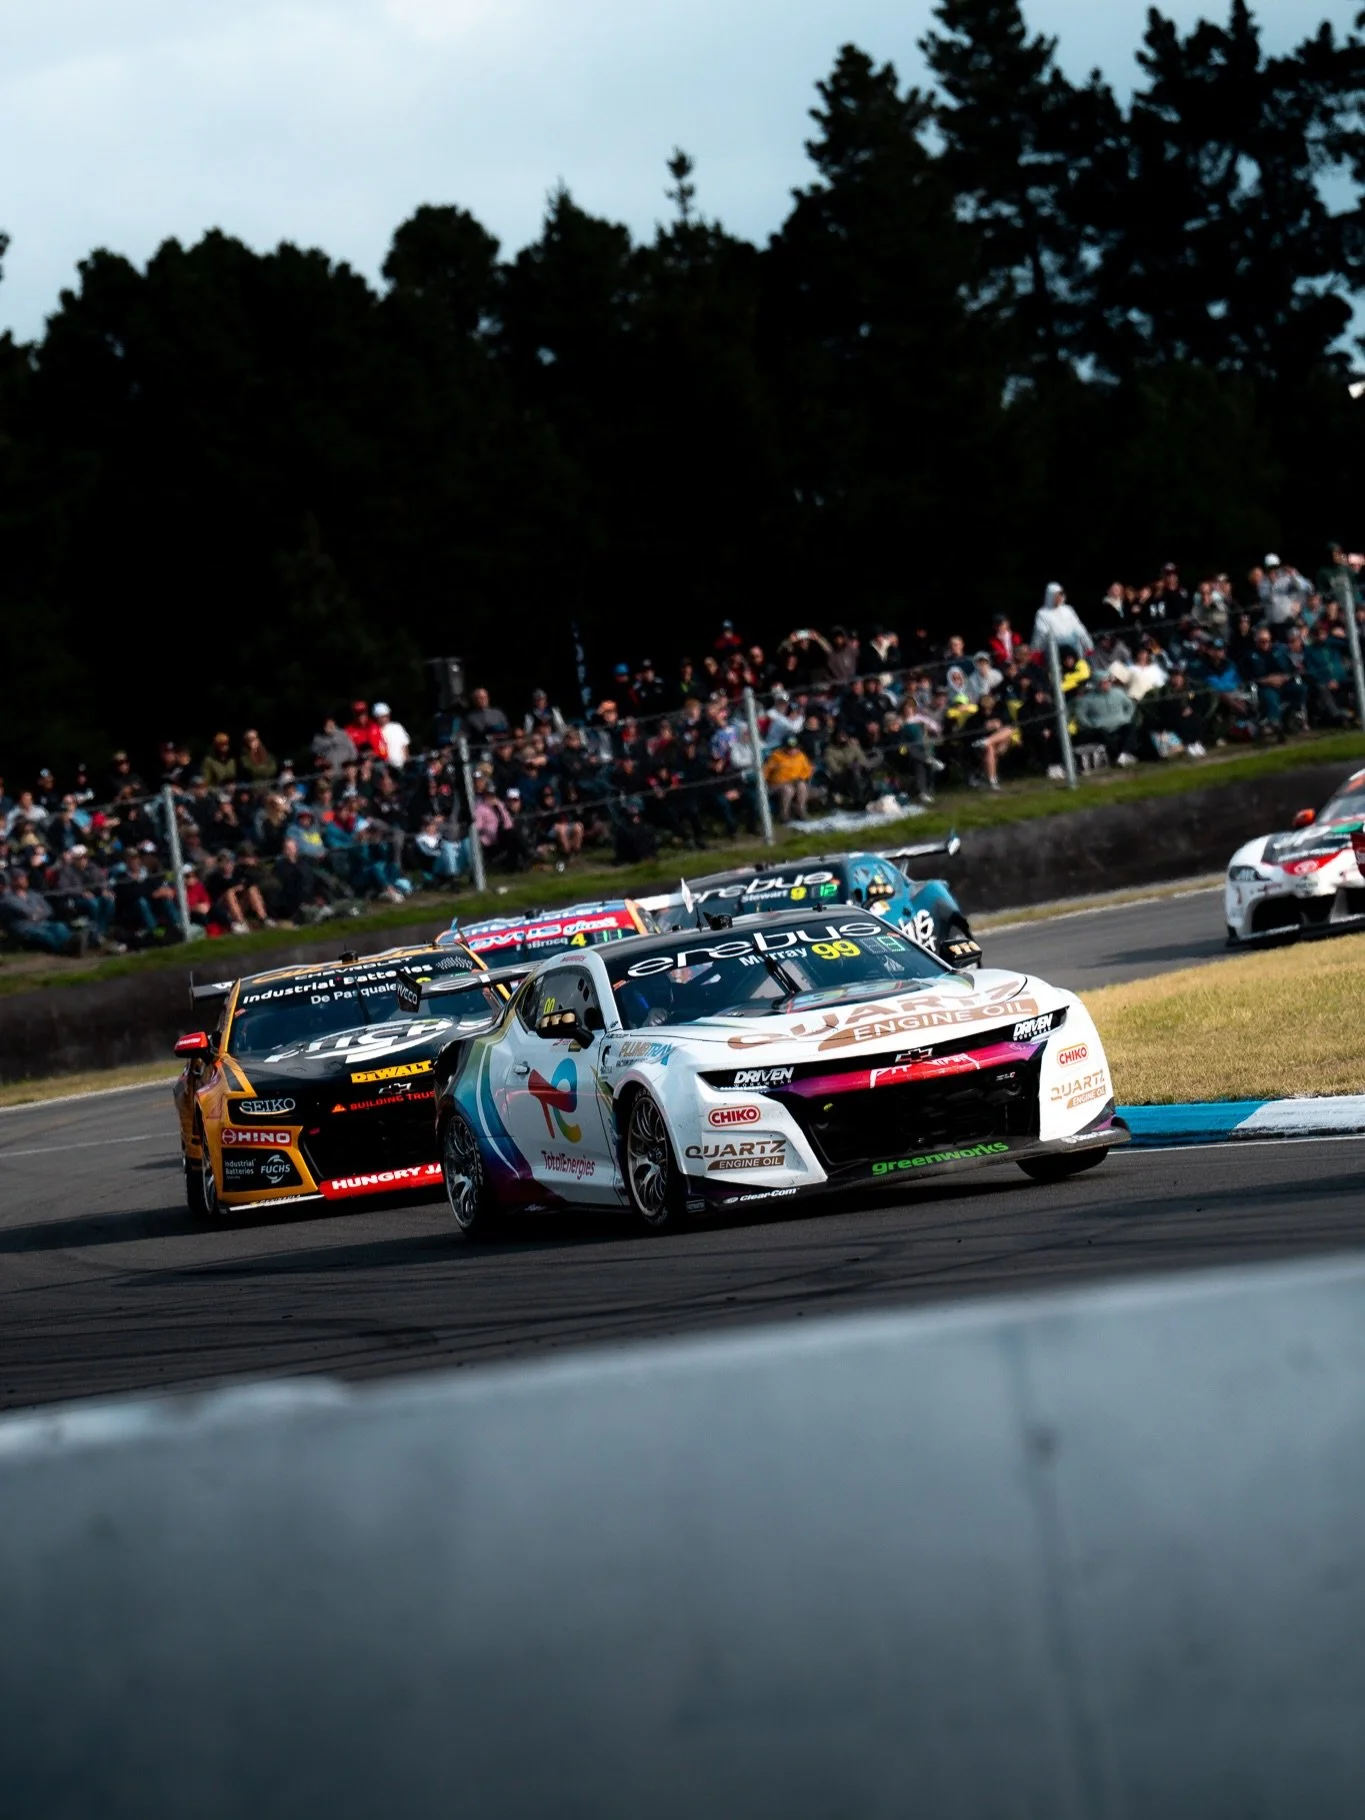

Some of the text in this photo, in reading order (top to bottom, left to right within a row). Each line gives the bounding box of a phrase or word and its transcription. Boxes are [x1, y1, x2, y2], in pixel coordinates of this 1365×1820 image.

[741, 889, 789, 904] Stewart
[570, 932, 588, 947] 4
[628, 922, 881, 977] erebus
[811, 939, 861, 960] 99
[243, 978, 335, 1004] Industrial
[342, 963, 433, 986] Batteies
[310, 992, 331, 1006] De
[726, 980, 1031, 1050] QUARTZ
[854, 1001, 1032, 1041] ENGINE OIL
[1013, 1013, 1053, 1037] DRIVEN
[1059, 1047, 1088, 1065] CHIKO
[733, 1066, 795, 1085] DRIVEN
[241, 1097, 296, 1113] SEIKO
[350, 1090, 436, 1111] BUILDING TRUS
[711, 1108, 758, 1124] CHIKO
[238, 1130, 291, 1144] HINO
[685, 1139, 787, 1160] QUARTZ
[872, 1141, 1009, 1176] greenworks
[224, 1159, 255, 1168] Industrial
[225, 1166, 255, 1176] Batteries
[260, 1163, 291, 1175] FUCHS
[541, 1149, 596, 1180] TotalEnergies
[718, 1157, 781, 1169] ENGINE OIL
[331, 1166, 420, 1191] HUNGRY
